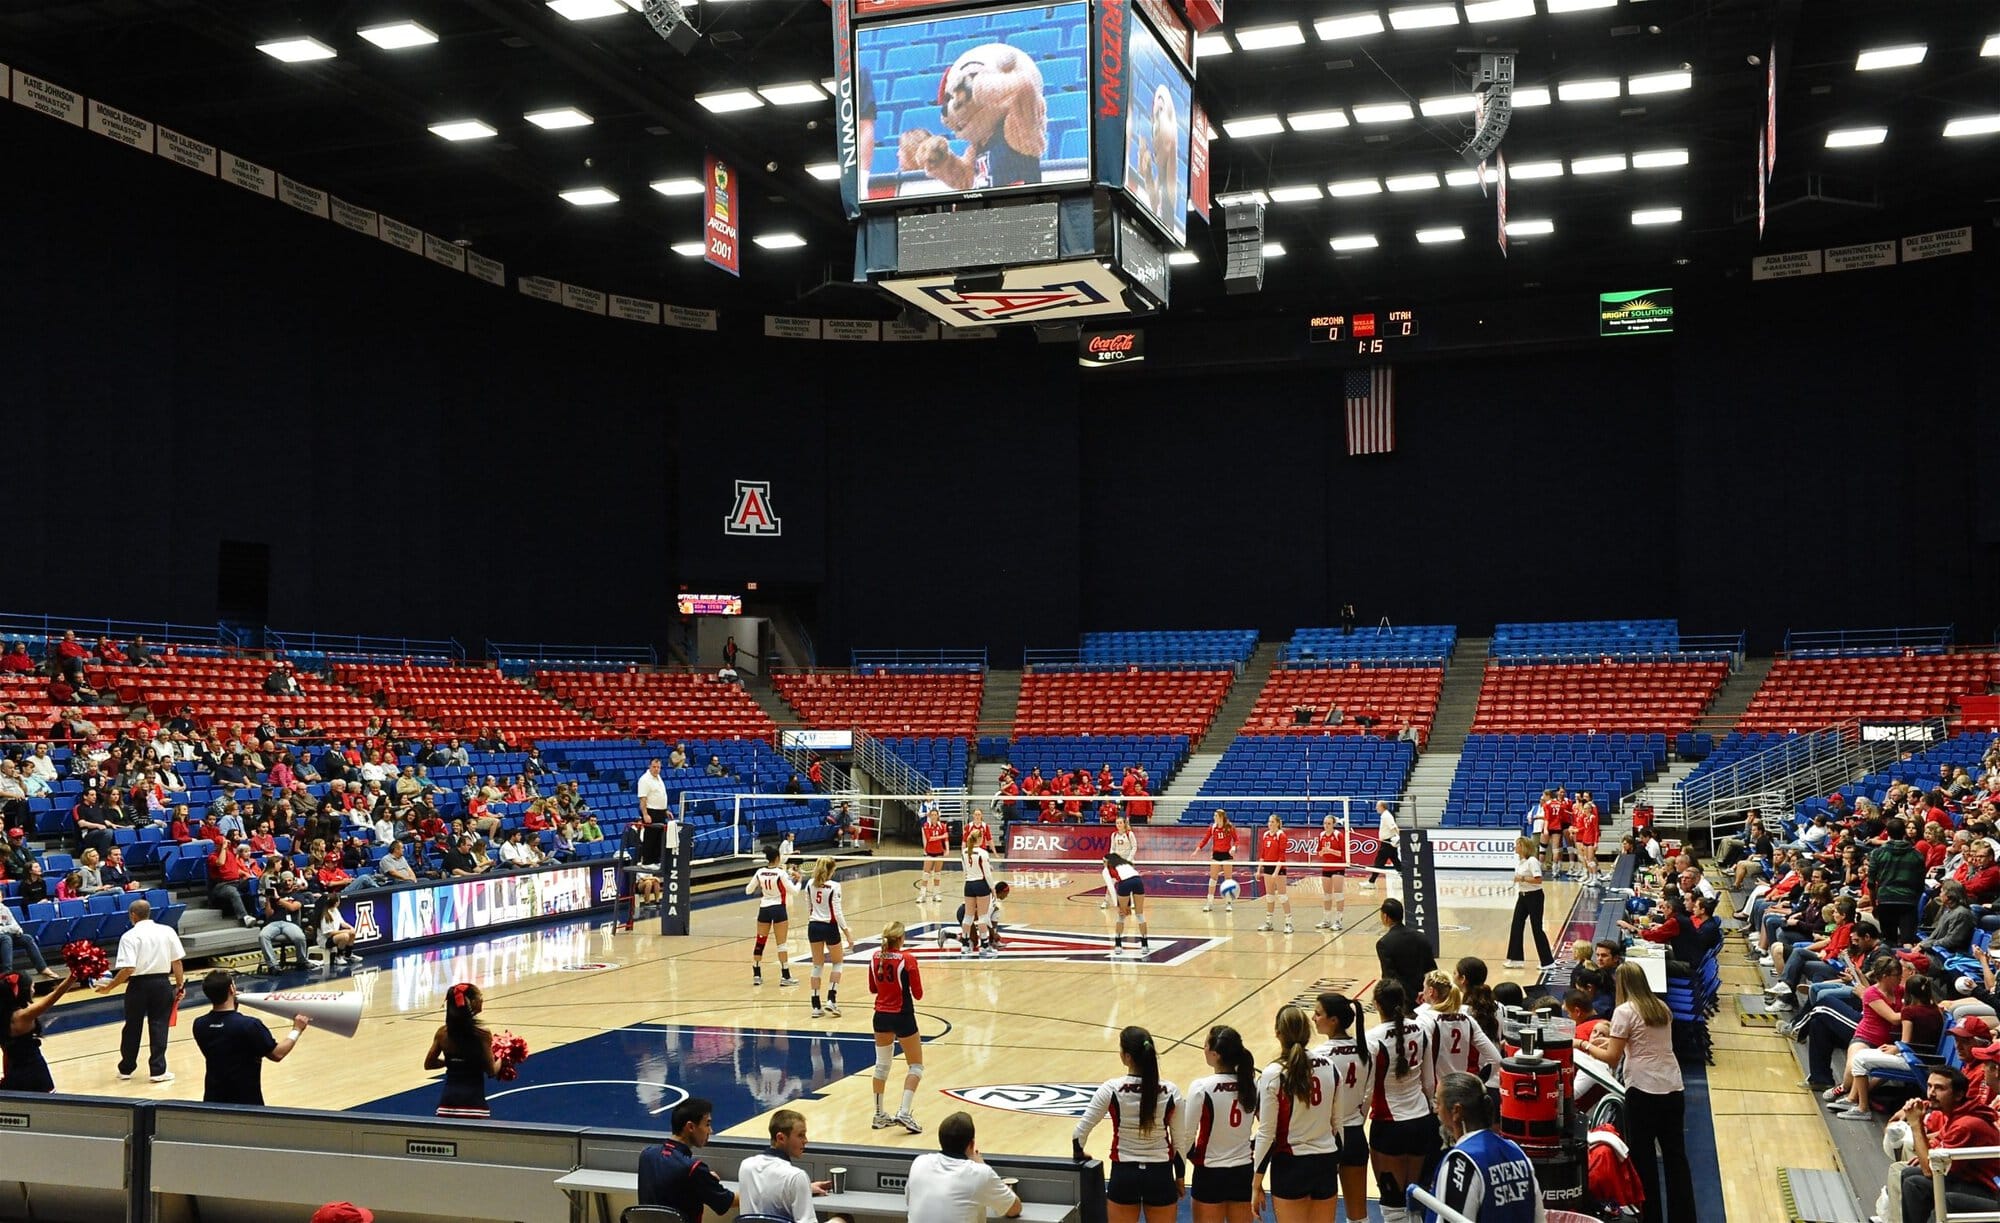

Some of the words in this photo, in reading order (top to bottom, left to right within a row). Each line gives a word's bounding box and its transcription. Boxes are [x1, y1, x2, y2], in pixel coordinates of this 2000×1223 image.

[27, 89, 70, 111] GYMNASTICS
[45, 84, 74, 103] JOHNSON
[97, 104, 120, 121] MONICA
[102, 117, 141, 138] GYMNASTICS
[169, 142, 204, 162] GYMNASTICS
[708, 217, 736, 239] ARIZONA
[1906, 237, 1919, 245] DEE
[1921, 234, 1934, 242] DEE
[1936, 229, 1966, 240] WHEELER
[712, 238, 733, 260] 2001
[1782, 253, 1807, 262] BARNES
[1311, 316, 1345, 327] ARIZONA
[1389, 311, 1412, 321] UTAH
[1602, 311, 1630, 320] BRIGHT
[1631, 308, 1674, 318] SOLUTIONS
[1089, 334, 1136, 352] Coca-Cola
[1329, 328, 1338, 340] 0
[1359, 340, 1383, 354] 1:15
[725, 480, 781, 536] A
[1012, 835, 1068, 851] BEAR
[1063, 836, 1109, 851] DOW
[601, 867, 618, 902] A
[668, 847, 680, 916] RIZONA
[764, 880, 771, 890] 11
[816, 891, 822, 904] 5
[353, 900, 382, 943] A
[1451, 1028, 1461, 1054] 2
[1346, 1062, 1357, 1088] 4
[1230, 1099, 1242, 1127] 6
[1488, 1160, 1529, 1186] EVENT
